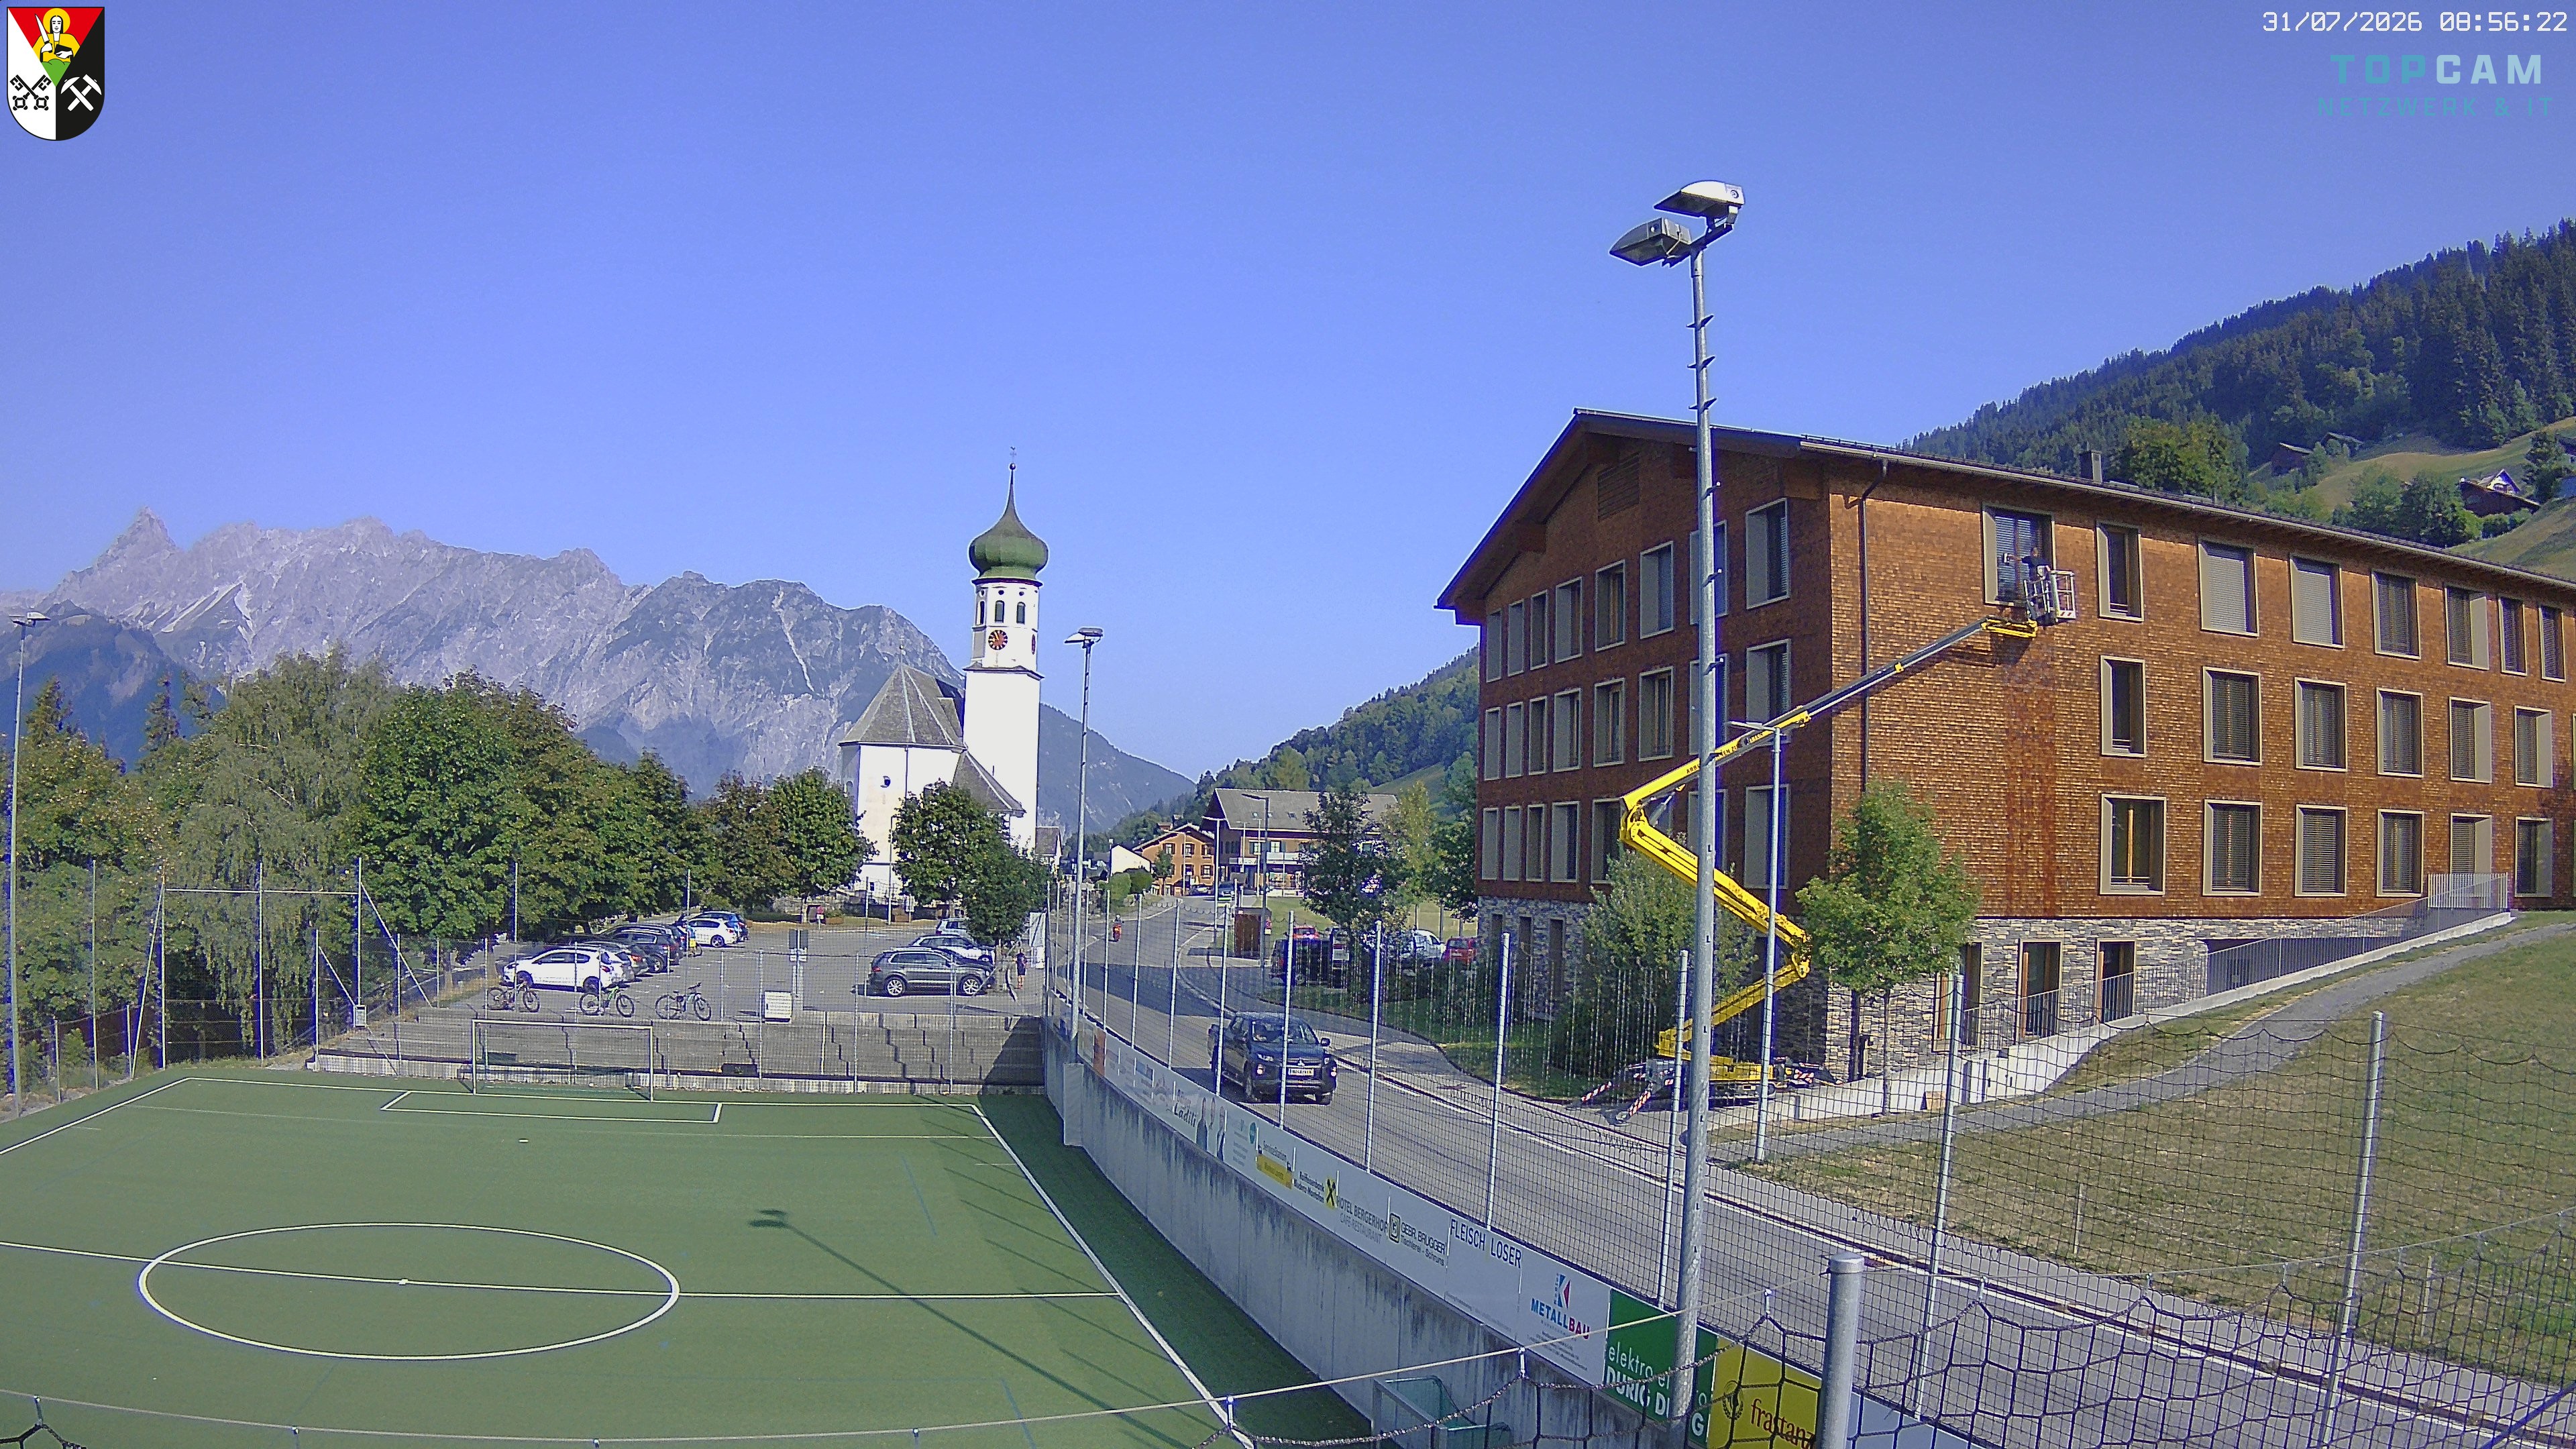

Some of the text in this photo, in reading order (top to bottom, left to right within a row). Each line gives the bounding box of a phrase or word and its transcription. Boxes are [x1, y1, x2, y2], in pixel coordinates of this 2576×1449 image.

[1337, 1196, 1388, 1233] HOTEL BERGERHOF
[1401, 1222, 1446, 1254] GEBR. BRUGGER
[1450, 1218, 1521, 1269] FLEISCH LOSER
[1531, 1297, 1591, 1340] METALLBAU
[1608, 1341, 1654, 1379] elektro
